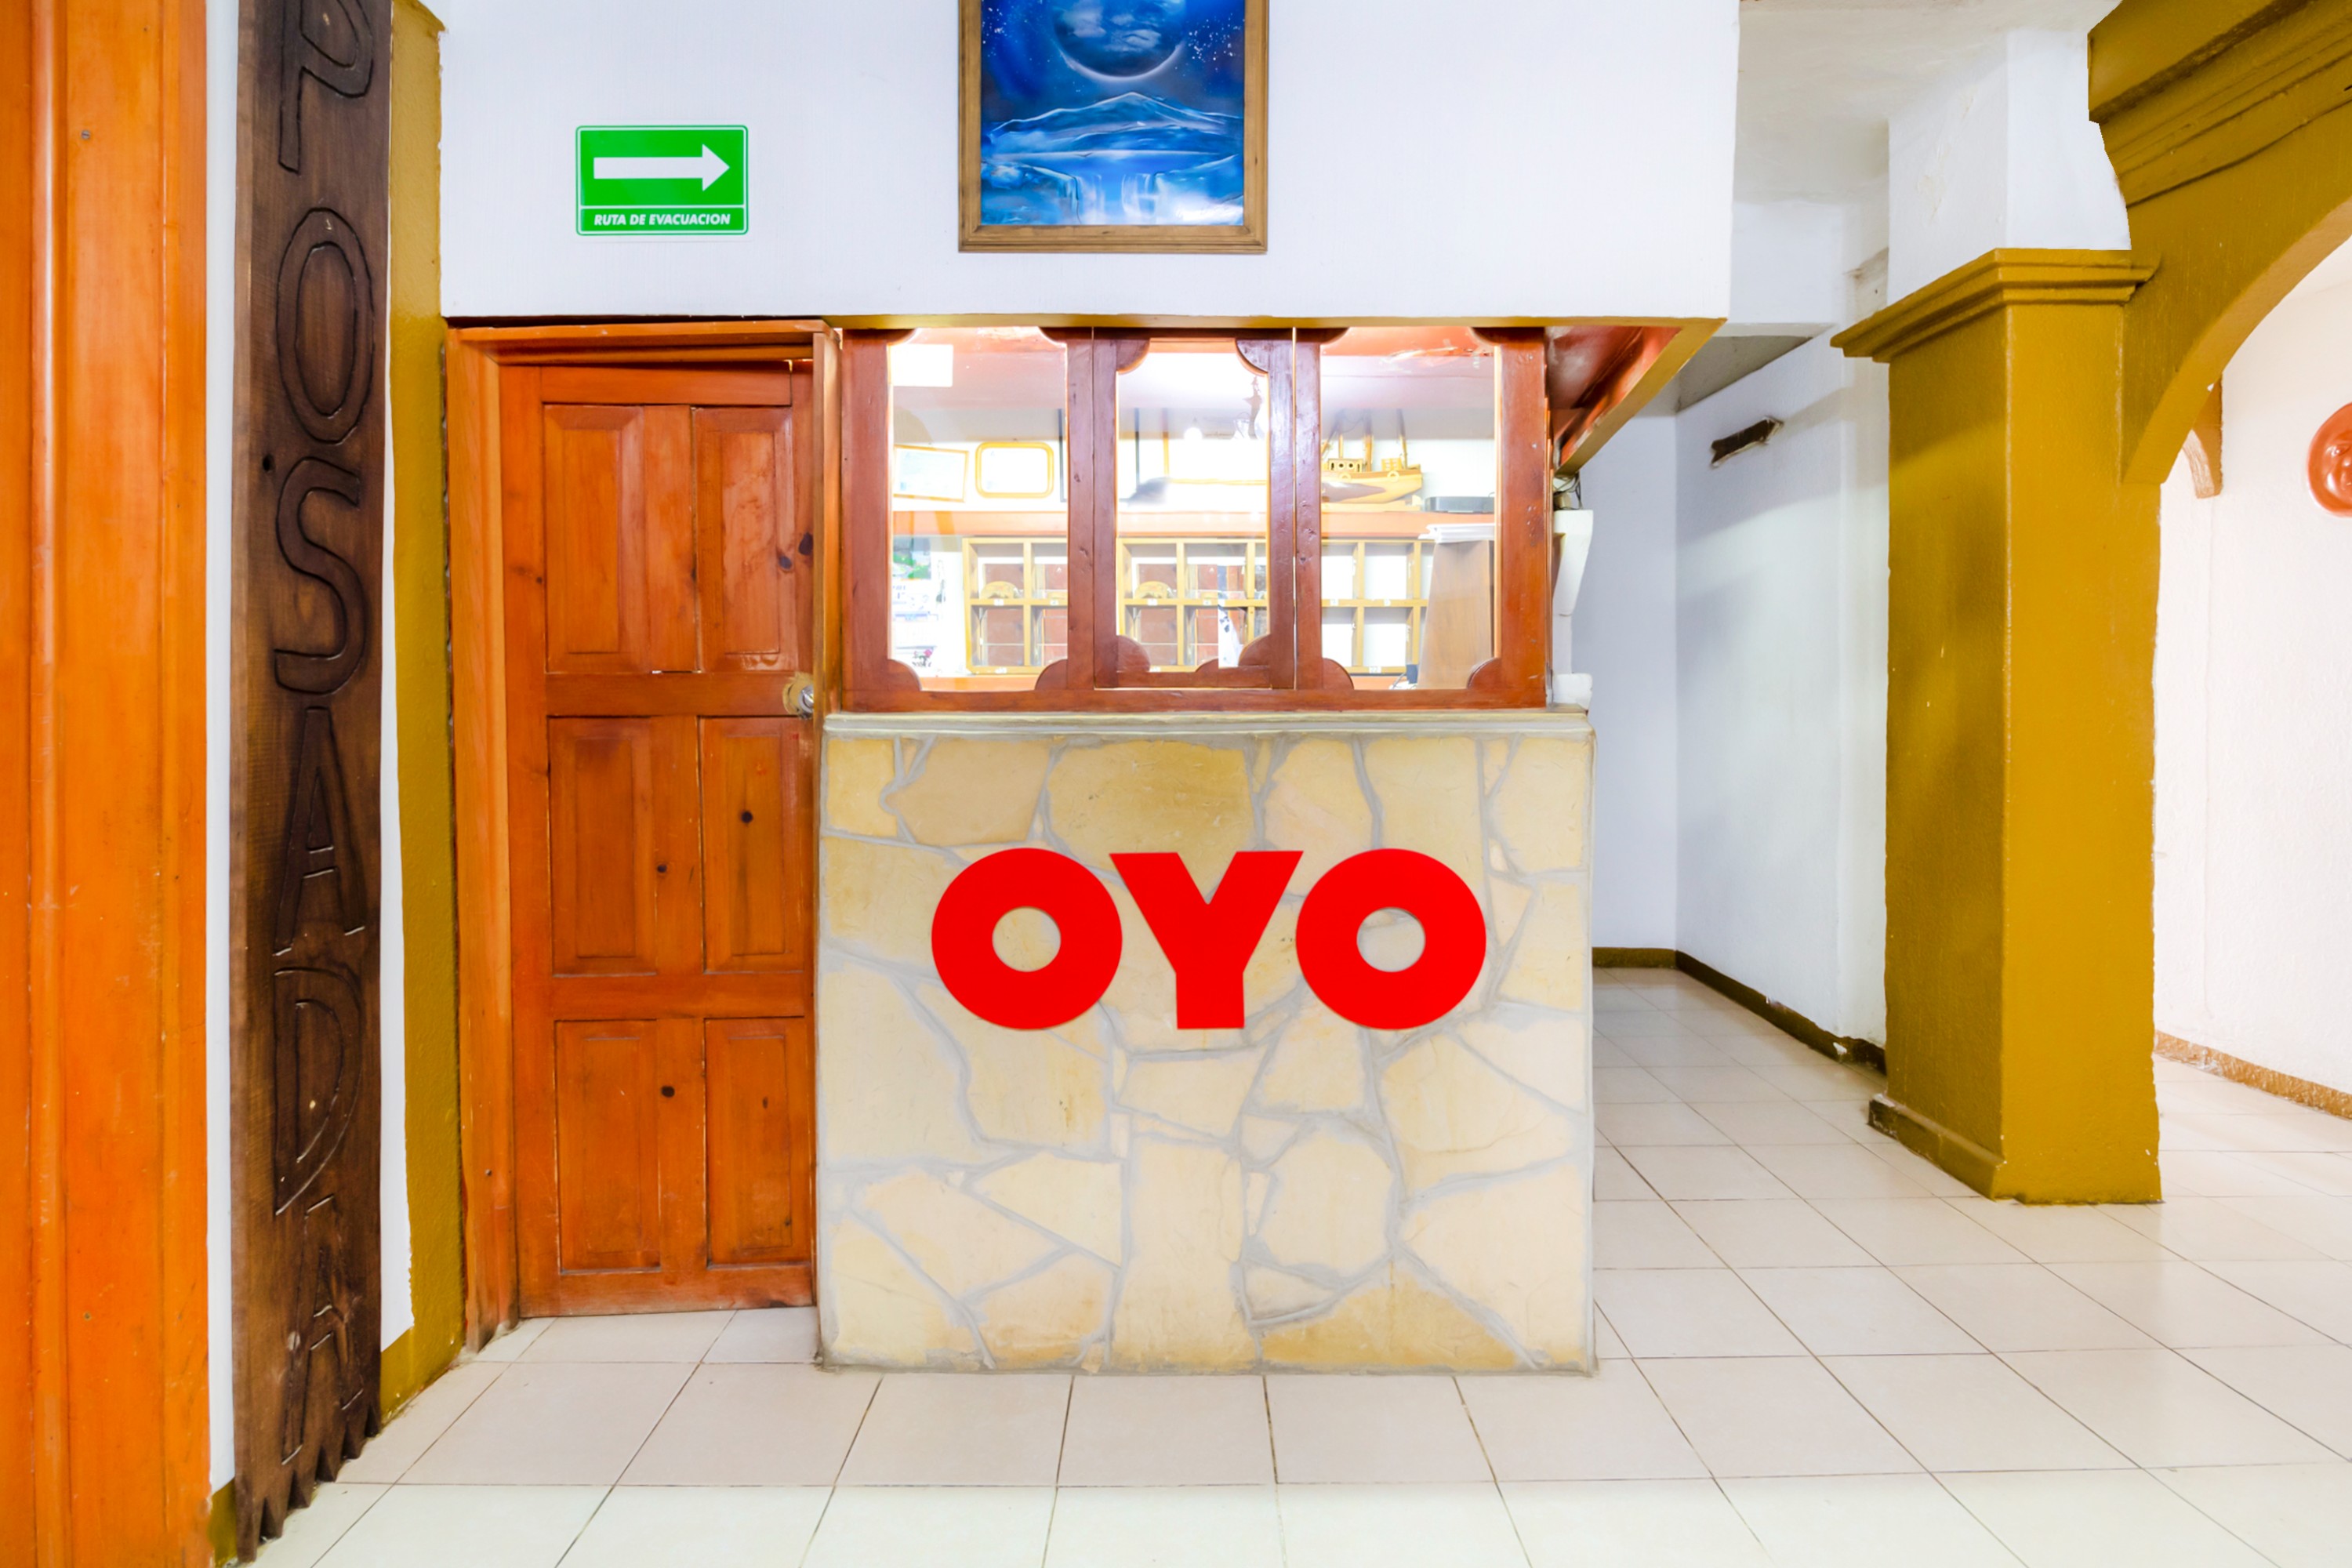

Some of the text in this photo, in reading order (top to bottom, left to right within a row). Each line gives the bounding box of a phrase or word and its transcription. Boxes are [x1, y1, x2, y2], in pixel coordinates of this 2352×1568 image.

[593, 213, 731, 225] RUTA DE EVACUACION
[273, 0, 374, 1465] POSADA
[931, 848, 1486, 1030] OYO
